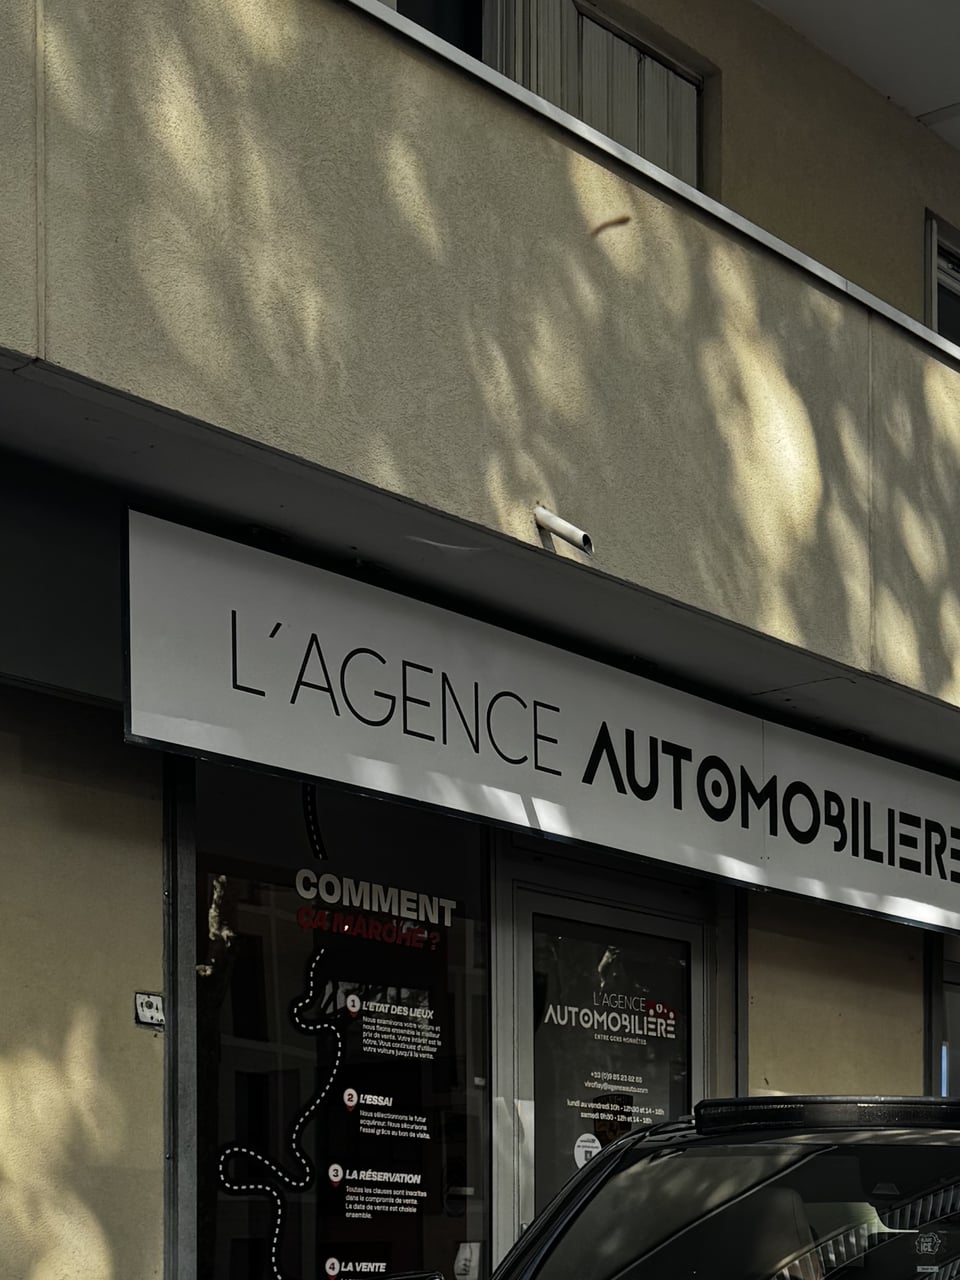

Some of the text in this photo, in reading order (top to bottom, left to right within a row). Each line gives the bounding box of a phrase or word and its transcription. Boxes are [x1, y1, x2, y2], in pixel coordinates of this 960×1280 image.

[230, 609, 562, 777] L'AGENCE
[296, 868, 457, 927] COMMENT
[332, 910, 425, 949] MARCHE
[428, 930, 441, 952] ?
[593, 991, 646, 1012] L'AGENCE
[390, 1005, 409, 1016] DES
[409, 1007, 434, 1019] LIEUX
[360, 1094, 393, 1106] L'ESSAI
[345, 1169, 358, 1179] LA
[359, 1169, 421, 1184] RÉSERVATION
[372, 1187, 392, 1195] clauses
[341, 1261, 353, 1272] LA
[354, 1262, 387, 1272] VENTE
